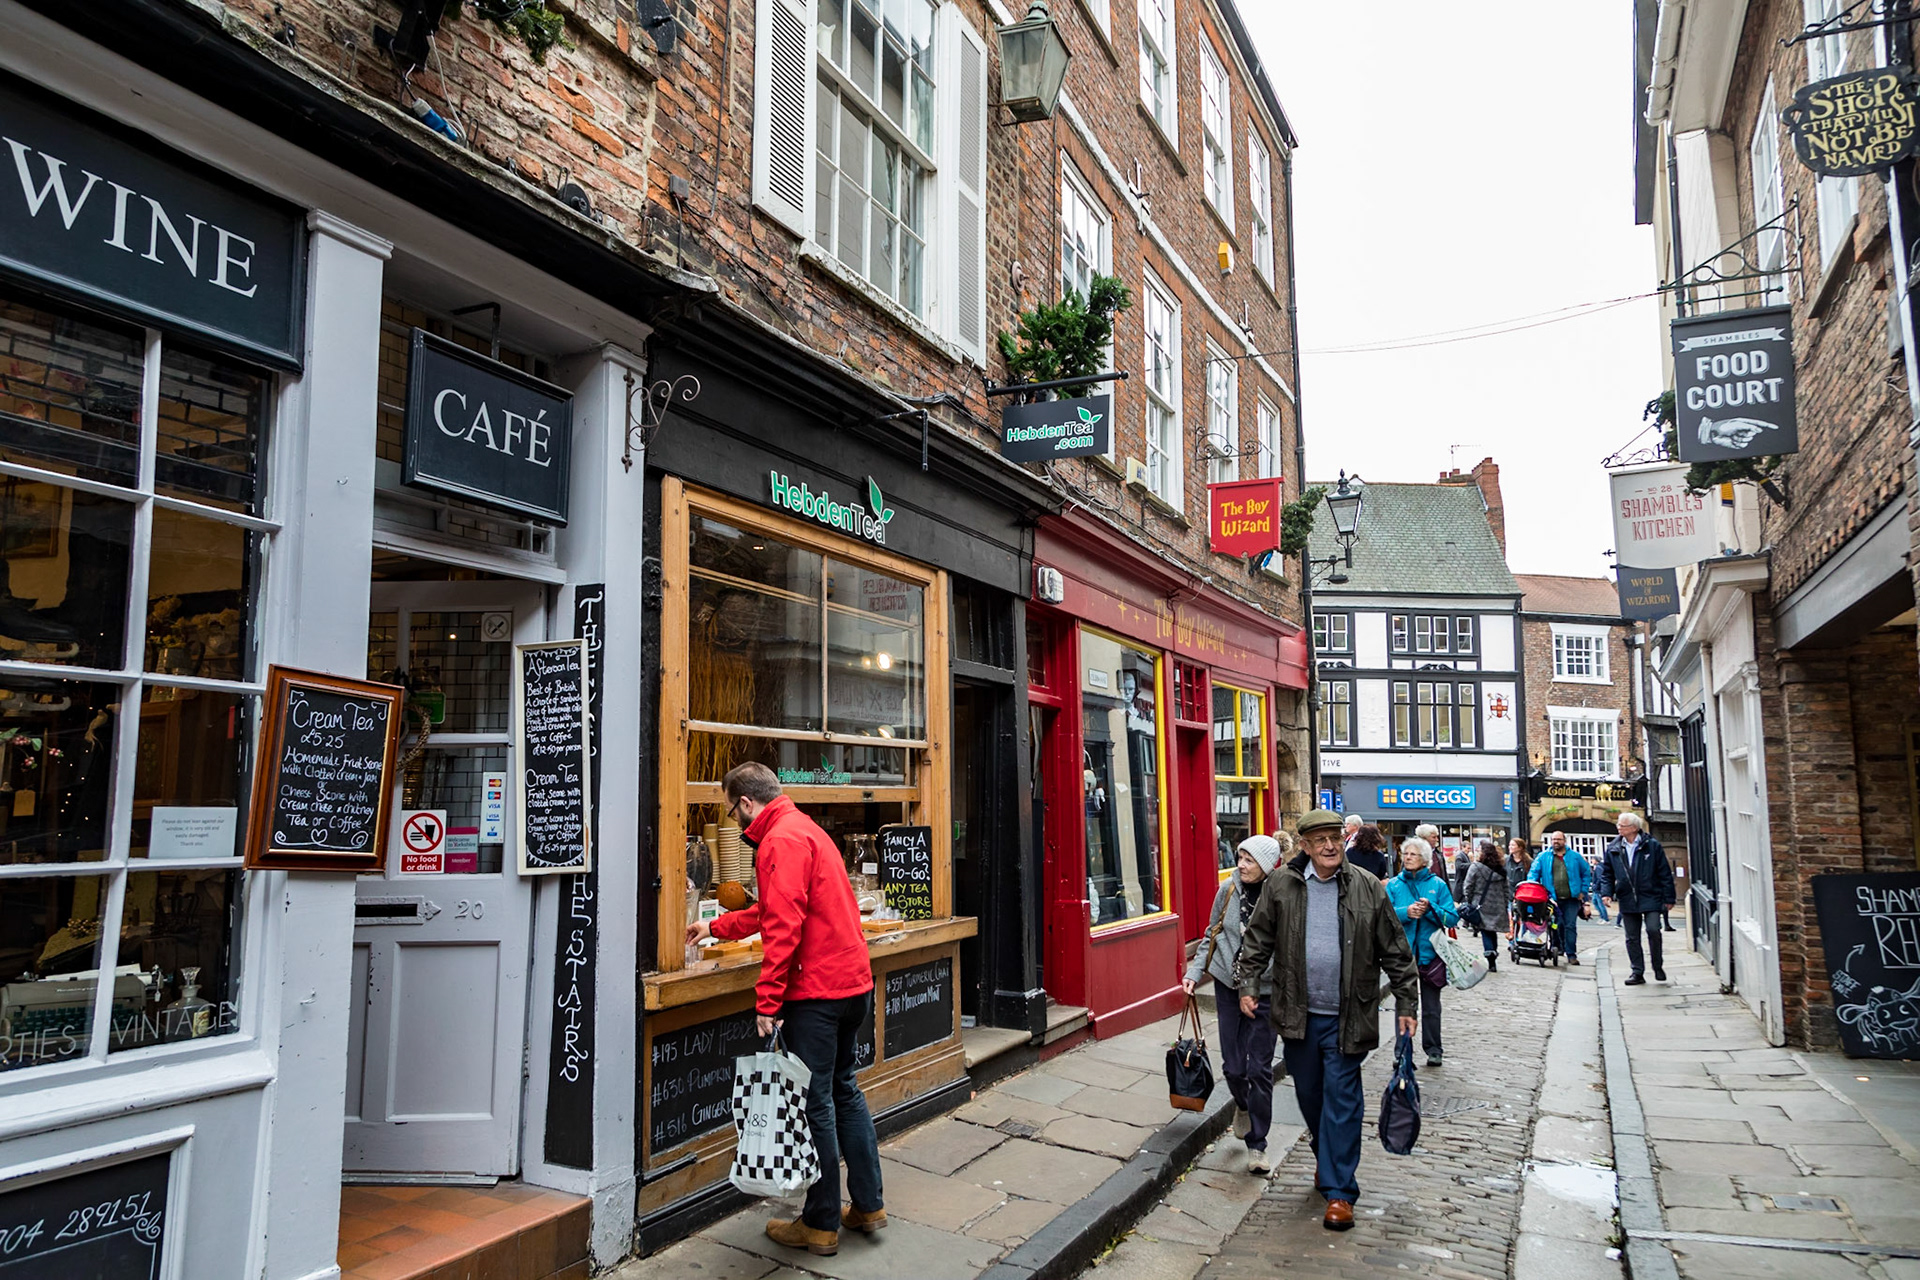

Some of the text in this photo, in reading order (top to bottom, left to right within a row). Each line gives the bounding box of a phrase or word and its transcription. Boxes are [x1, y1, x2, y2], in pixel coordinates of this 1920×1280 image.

[1830, 76, 1872, 97] THE
[1809, 75, 1898, 120] SHOP
[1801, 112, 1863, 133] THAT
[1803, 122, 1914, 160] NOT BE
[1823, 141, 1901, 169] NAMED
[2, 136, 258, 298] WINE
[1703, 331, 1760, 344] SHAMBLES
[1695, 350, 1770, 381] FOOD
[1686, 377, 1785, 411] COURT
[433, 388, 552, 468] CAFÉ
[1006, 420, 1094, 442] HebdenTea
[1054, 435, 1094, 451] .com
[1660, 485, 1673, 493] 28
[770, 470, 886, 545] HebdenTea
[1220, 498, 1270, 517] The Boy
[1620, 494, 1703, 519] SHAMBLES
[1221, 516, 1270, 537] Wizard
[1631, 515, 1696, 541] KITCHEN
[1630, 576, 1664, 587] WORLD
[1626, 595, 1672, 606] WIZARDRY
[555, 650, 581, 672] Tea
[293, 700, 375, 731] Cream Tea
[284, 745, 340, 766] Homemade
[1322, 759, 1341, 767] TIVE
[317, 781, 328, 789] or
[525, 768, 560, 787] Cream
[558, 763, 579, 783] Tea
[280, 784, 312, 798] Cheese
[316, 788, 346, 802] Scone
[1400, 788, 1471, 804] GREGGS
[1546, 784, 1581, 798] Golden
[286, 814, 362, 834] Tea or Coffee
[883, 831, 926, 847] FANCY A
[420, 855, 438, 863] food
[883, 847, 930, 864] HOT TEA
[416, 863, 437, 871] drink
[889, 862, 931, 880] TO-GO?
[884, 883, 930, 895] ANY TEA
[454, 899, 485, 920] 20
[897, 894, 931, 909] STORE
[557, 929, 589, 1083] STAIRS
[113, 1001, 232, 1045] VINTAGE
[652, 1041, 678, 1067] #195
[684, 1027, 715, 1057] LADY
[687, 1065, 732, 1093] PUMPKIN
[654, 1112, 687, 1146] #516
[54, 1191, 152, 1240] 289151
